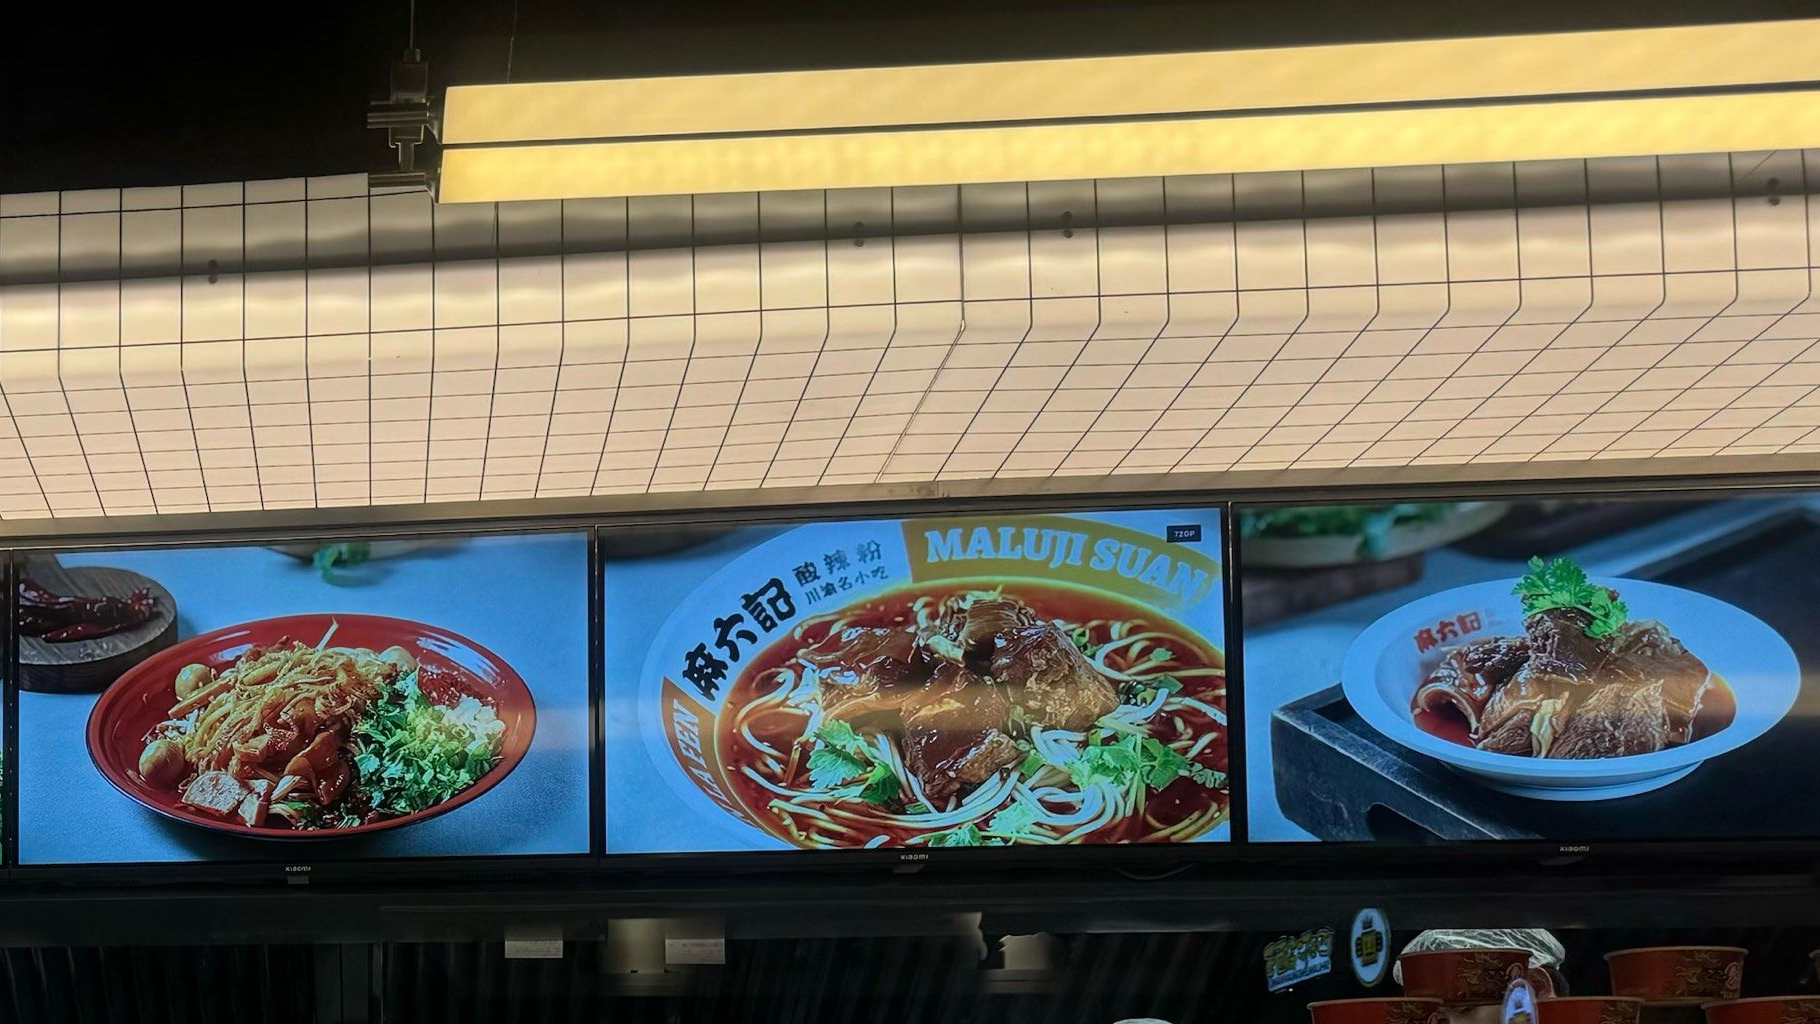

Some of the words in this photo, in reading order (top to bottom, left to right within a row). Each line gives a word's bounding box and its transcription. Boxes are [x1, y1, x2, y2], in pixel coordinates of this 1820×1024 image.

[924, 526, 1088, 568] MALUJI
[1089, 537, 1208, 602] SUAN
[1173, 530, 1196, 538] 720P
[673, 698, 708, 769] FEN
